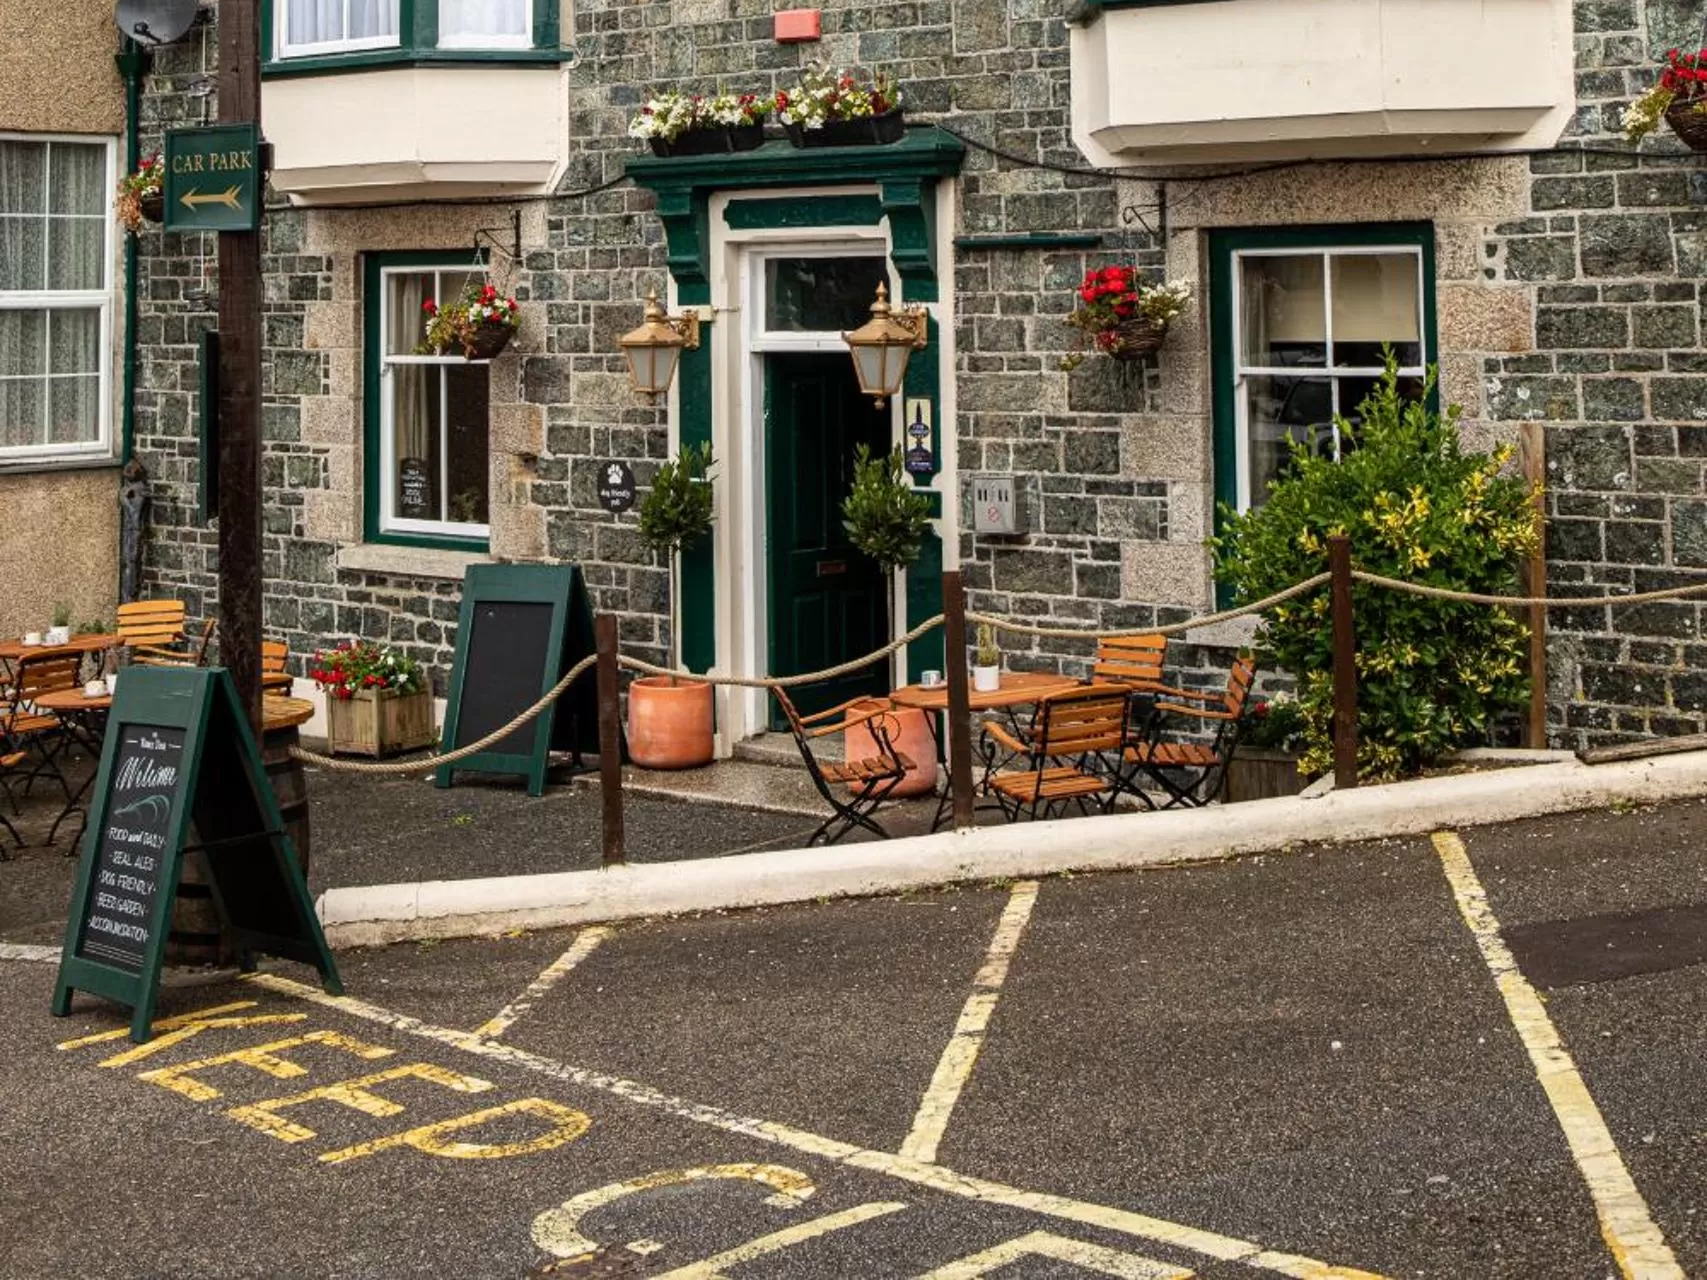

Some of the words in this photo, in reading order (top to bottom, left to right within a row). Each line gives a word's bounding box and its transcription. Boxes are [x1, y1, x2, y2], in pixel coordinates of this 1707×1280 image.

[172, 153, 204, 174] CAR
[209, 150, 252, 171] PARK
[56, 1001, 593, 1164] KEEP
